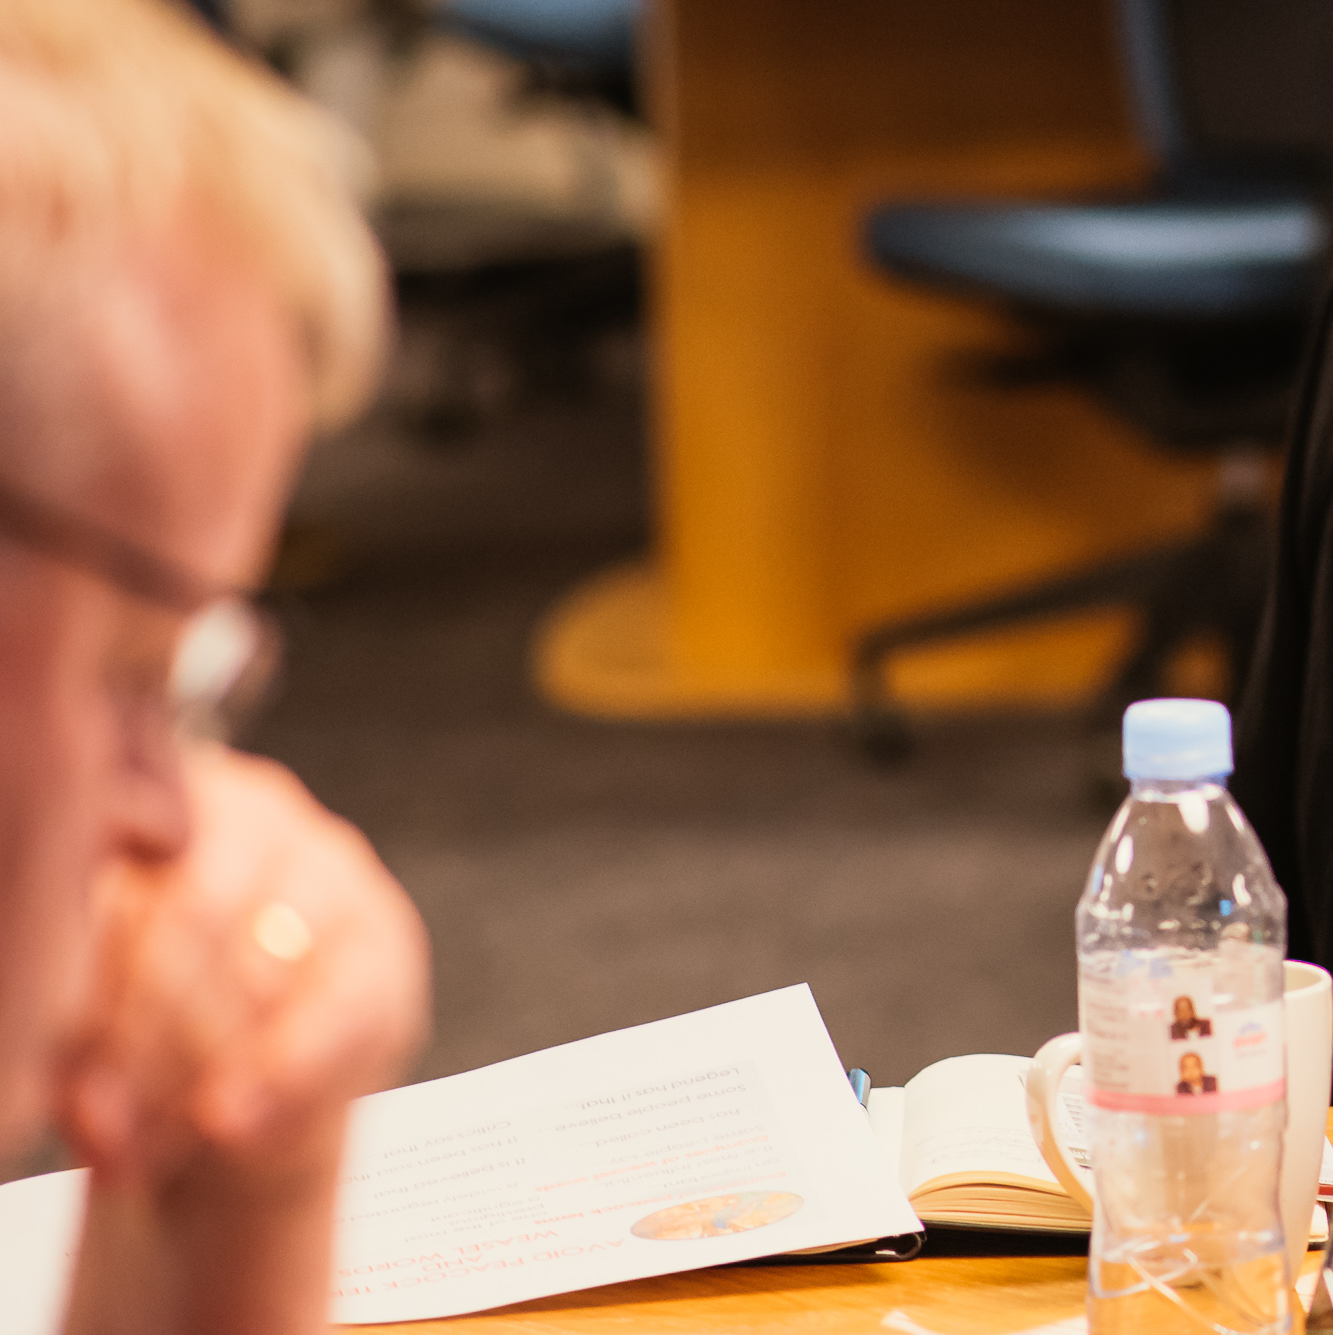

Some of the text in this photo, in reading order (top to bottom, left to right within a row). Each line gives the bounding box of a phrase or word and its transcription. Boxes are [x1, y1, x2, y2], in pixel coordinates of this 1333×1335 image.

[670, 1067, 740, 1089] Legend
[636, 1084, 667, 1096] has
[696, 1084, 747, 1100] Some
[626, 1095, 690, 1116] people
[457, 1121, 511, 1139] Critics
[424, 1135, 453, 1148] say
[417, 1149, 466, 1166] been
[413, 1165, 494, 1191] believed
[338, 1230, 558, 1277] WEASEL WORDS
[532, 1237, 624, 1262] AVOID
[422, 1253, 482, 1272] AND
[381, 1257, 524, 1291] PEACOCK
